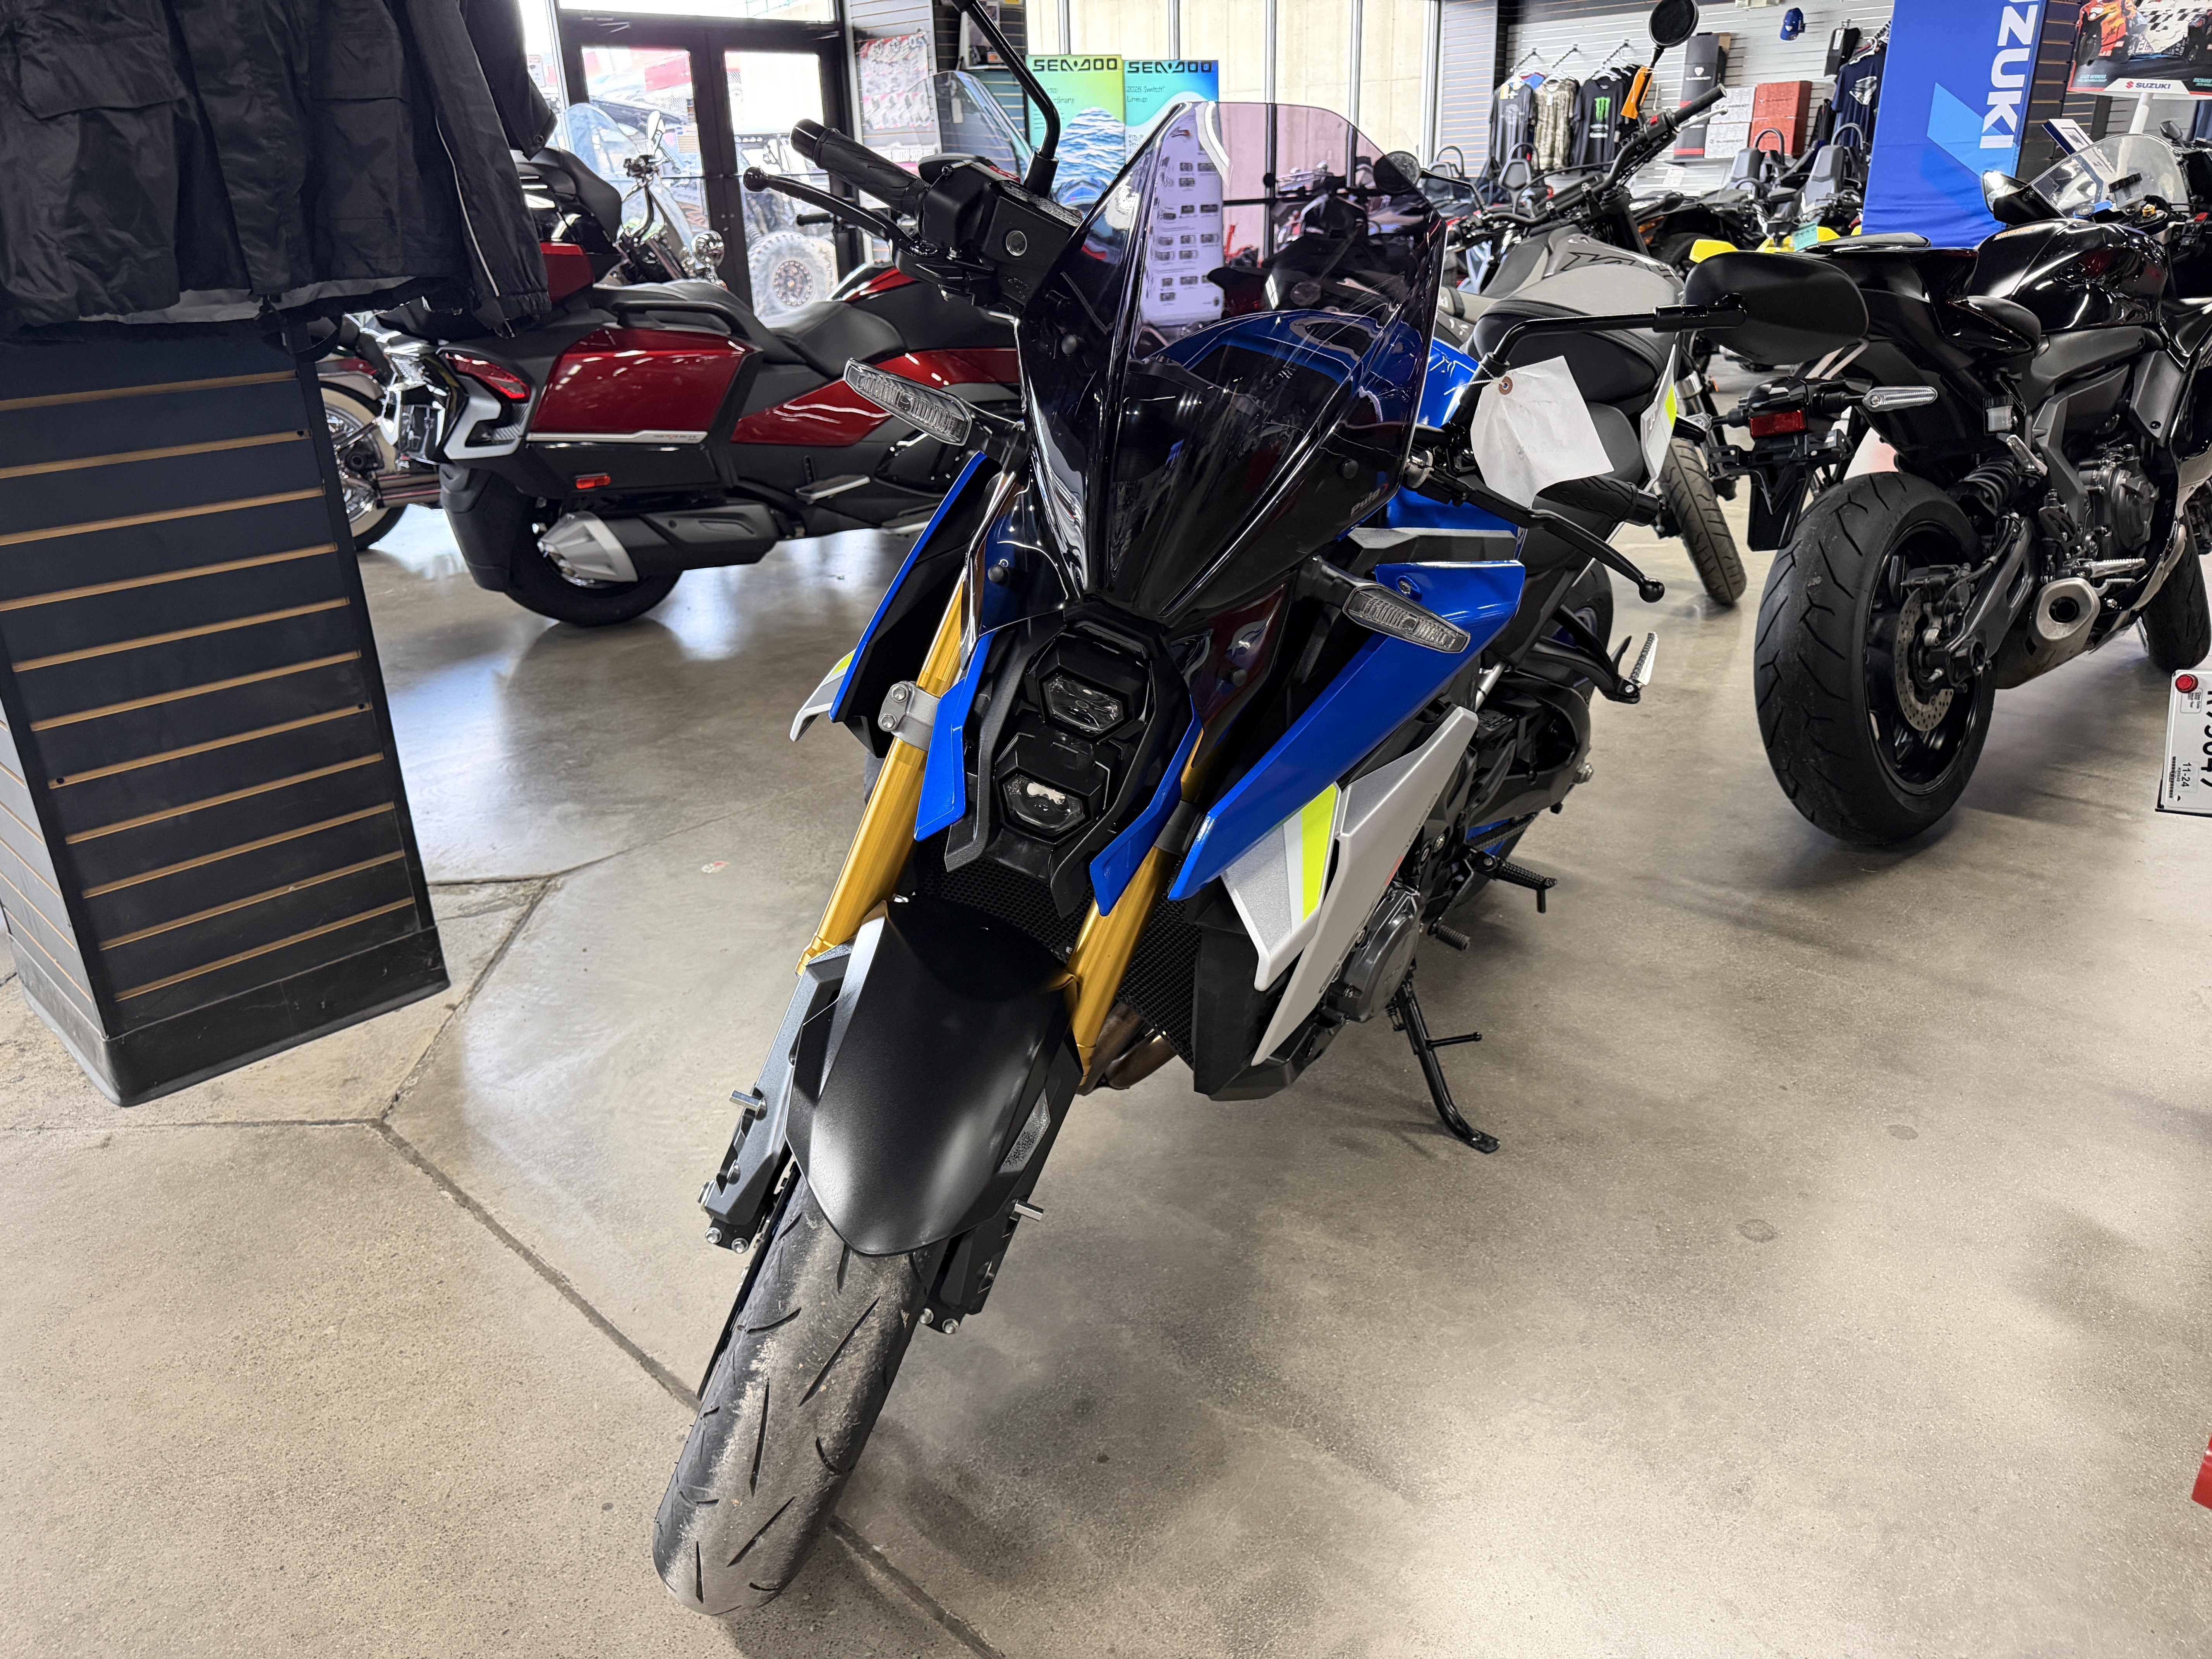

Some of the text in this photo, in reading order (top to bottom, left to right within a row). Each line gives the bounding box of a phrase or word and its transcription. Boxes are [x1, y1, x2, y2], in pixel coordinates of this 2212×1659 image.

[1979, 0, 2038, 149] ZUKI
[1350, 488, 1381, 515] Puig
[2181, 762, 2192, 788] 11-24
